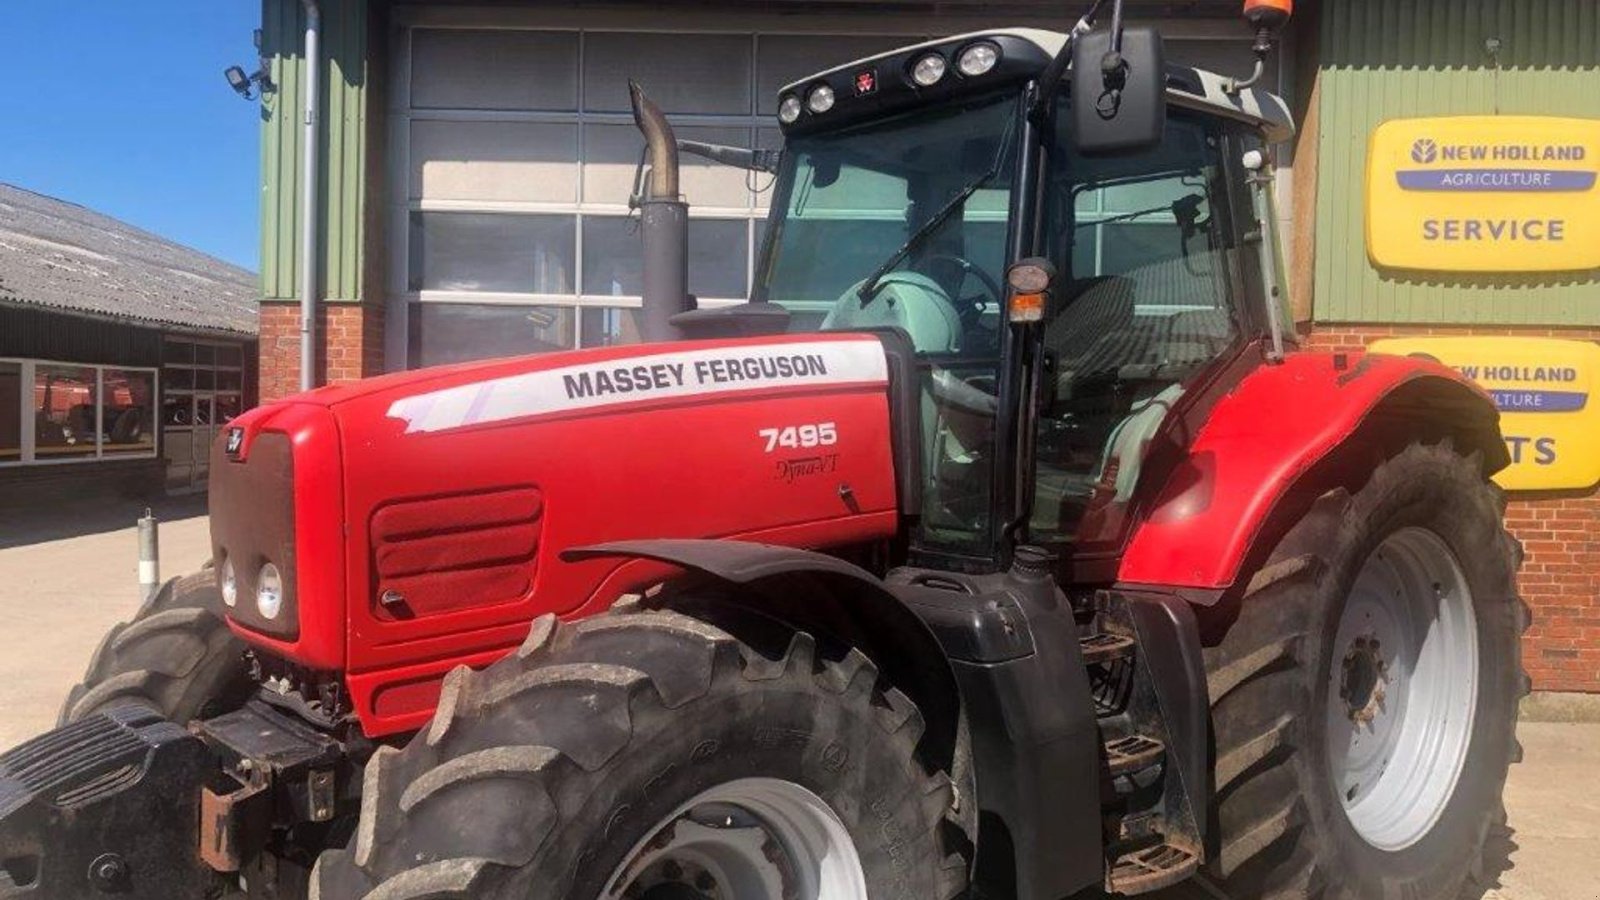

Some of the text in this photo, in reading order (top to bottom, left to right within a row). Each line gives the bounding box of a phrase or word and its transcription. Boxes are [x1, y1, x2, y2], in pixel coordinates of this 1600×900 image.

[1441, 146, 1586, 161] NEW HOLLAND
[1441, 173, 1551, 186] AGRICULTURE
[1423, 220, 1564, 240] SERVICE
[563, 354, 828, 400] MASSEY FERGUSON
[1484, 366, 1577, 382] HOLLAND
[759, 422, 838, 453] 7495
